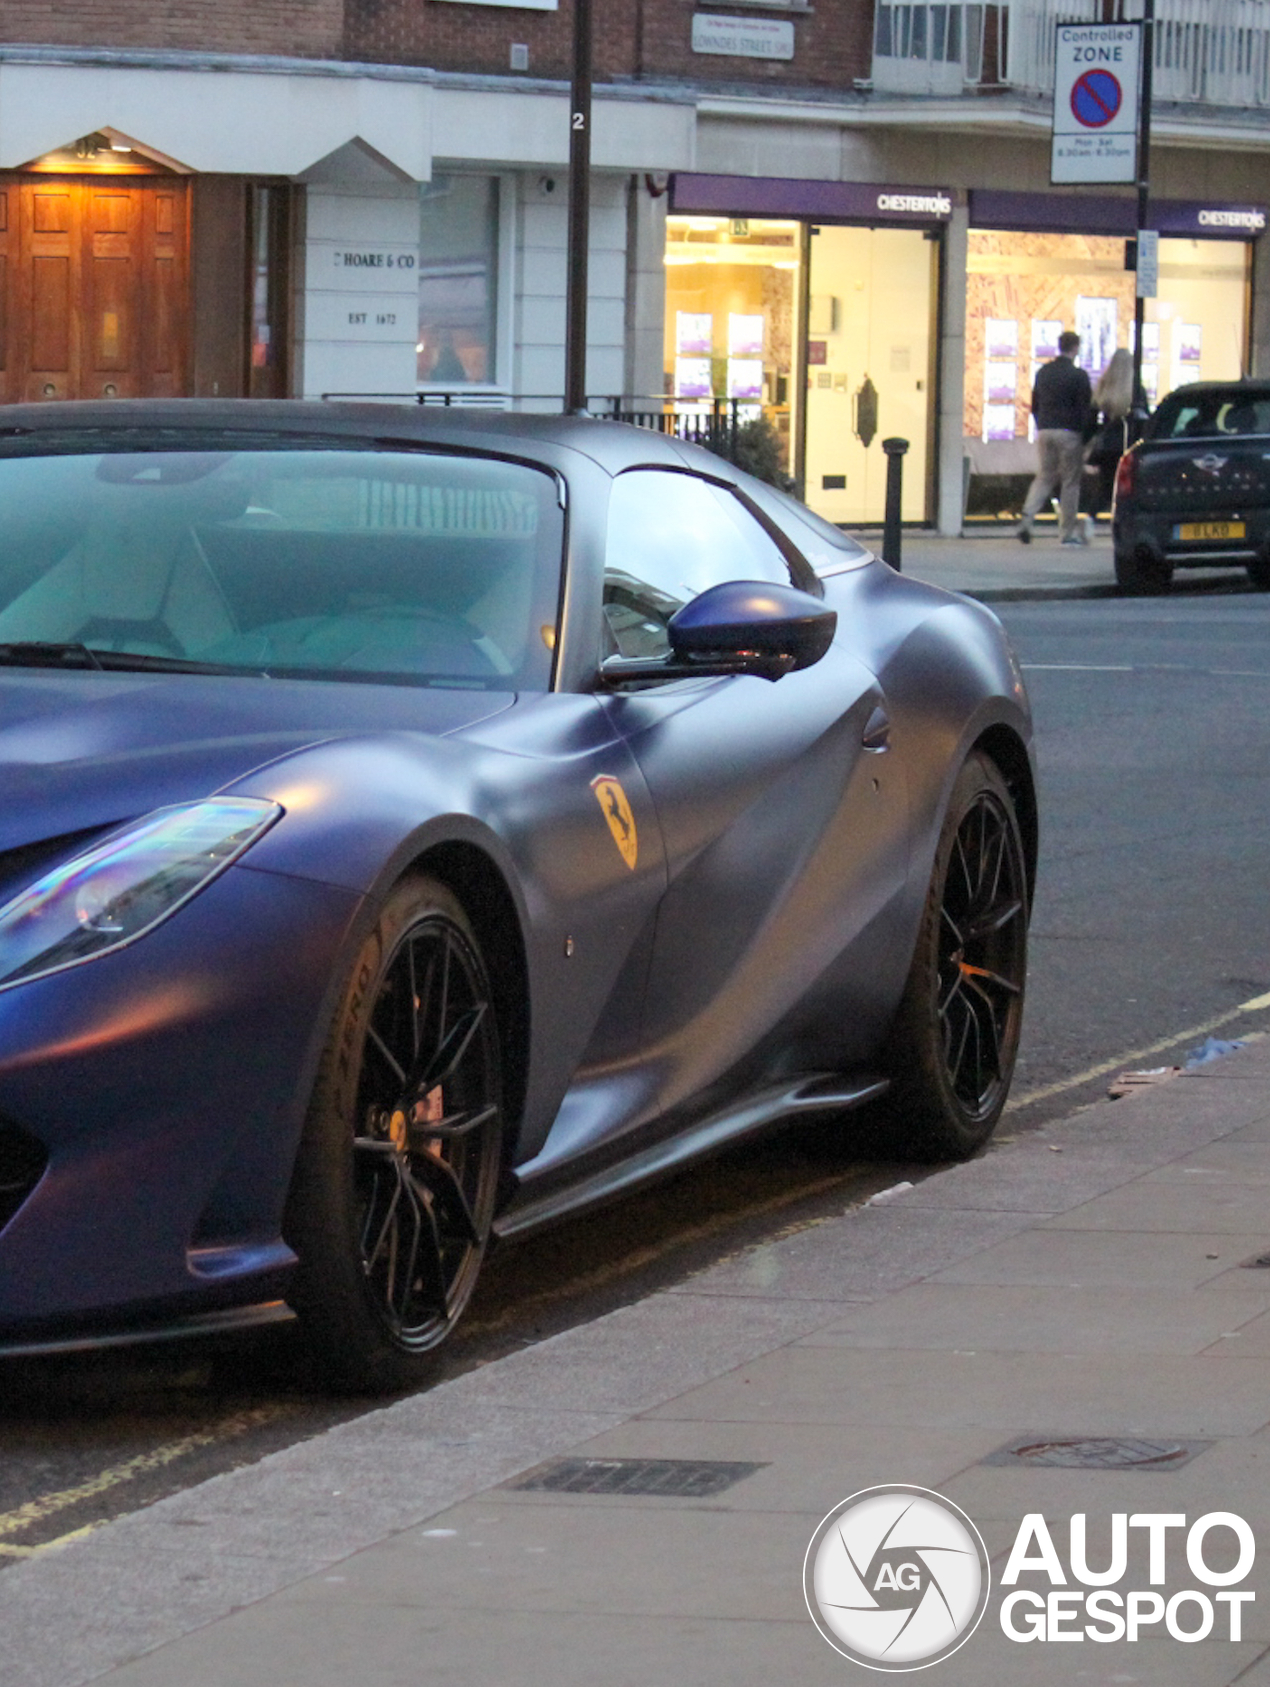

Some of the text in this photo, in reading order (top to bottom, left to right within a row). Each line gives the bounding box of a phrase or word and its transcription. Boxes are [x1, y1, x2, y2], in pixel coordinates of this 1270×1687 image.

[1062, 28, 1133, 42] Controlled
[1074, 46, 1123, 62] ZONE
[572, 112, 585, 130] 2
[877, 191, 952, 218] CHESTERTONS
[1197, 208, 1266, 232] CHESTERTONS
[343, 252, 384, 268] HOARE
[397, 254, 415, 269] CO
[348, 312, 368, 324] EST
